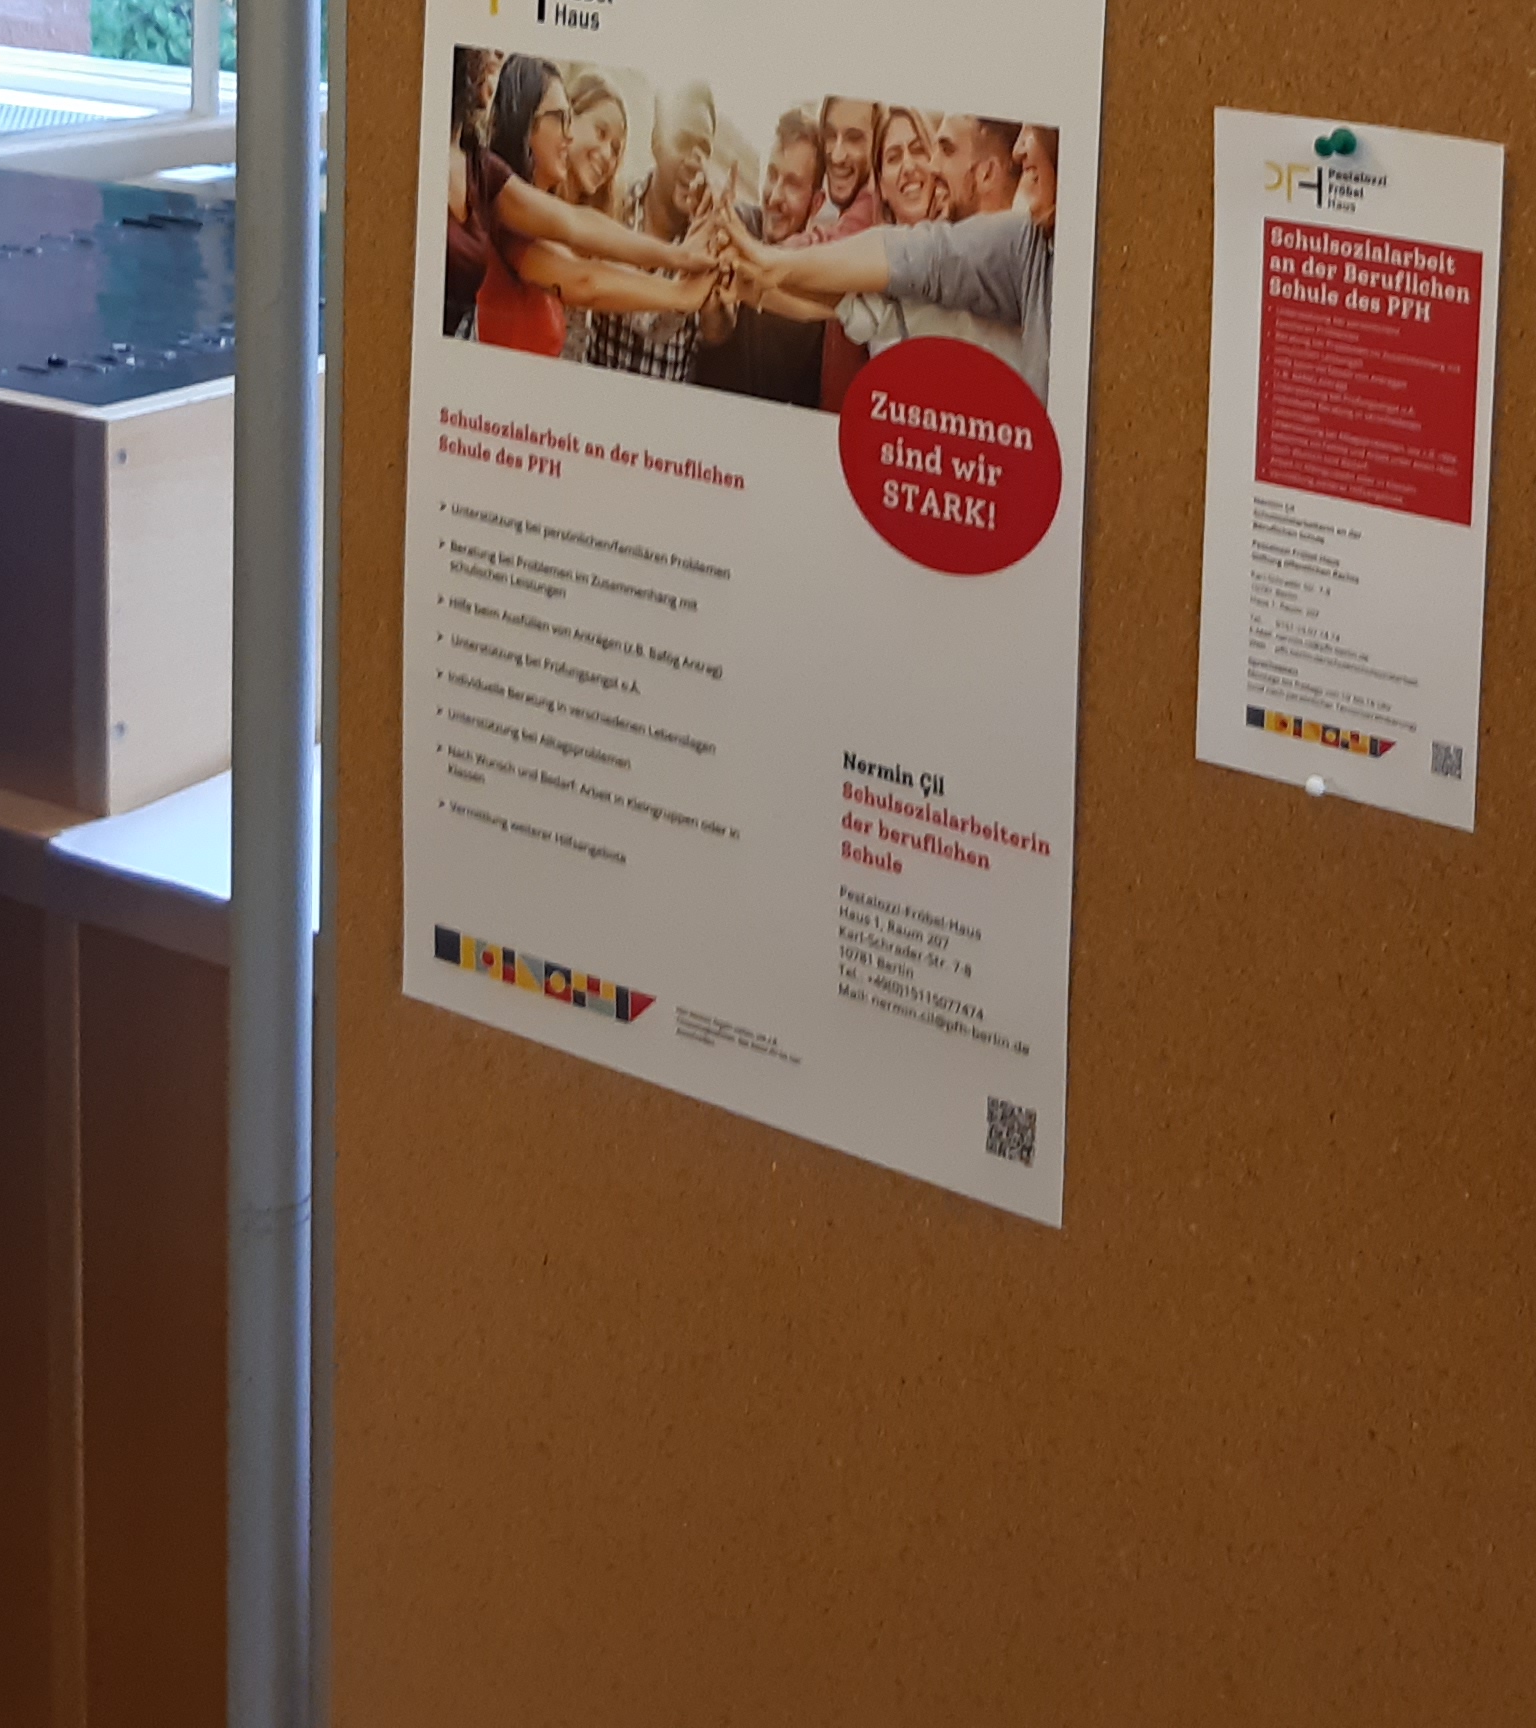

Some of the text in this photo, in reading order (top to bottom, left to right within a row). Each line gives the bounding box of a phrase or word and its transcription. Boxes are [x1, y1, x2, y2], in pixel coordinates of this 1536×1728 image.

[553, 2, 600, 31] Haus
[869, 389, 1033, 451] Zusammen
[437, 433, 562, 479] Schule des PFH
[438, 406, 745, 490] Schulsozialarbeit an der beruflichen
[879, 435, 1002, 487] sind wir
[882, 478, 995, 530] STARK!
[842, 750, 944, 797] Nermin Çil
[840, 810, 990, 870] der beruflichen
[841, 780, 1051, 857] Schulsozialarbeiterin
[840, 839, 903, 875] Schule
